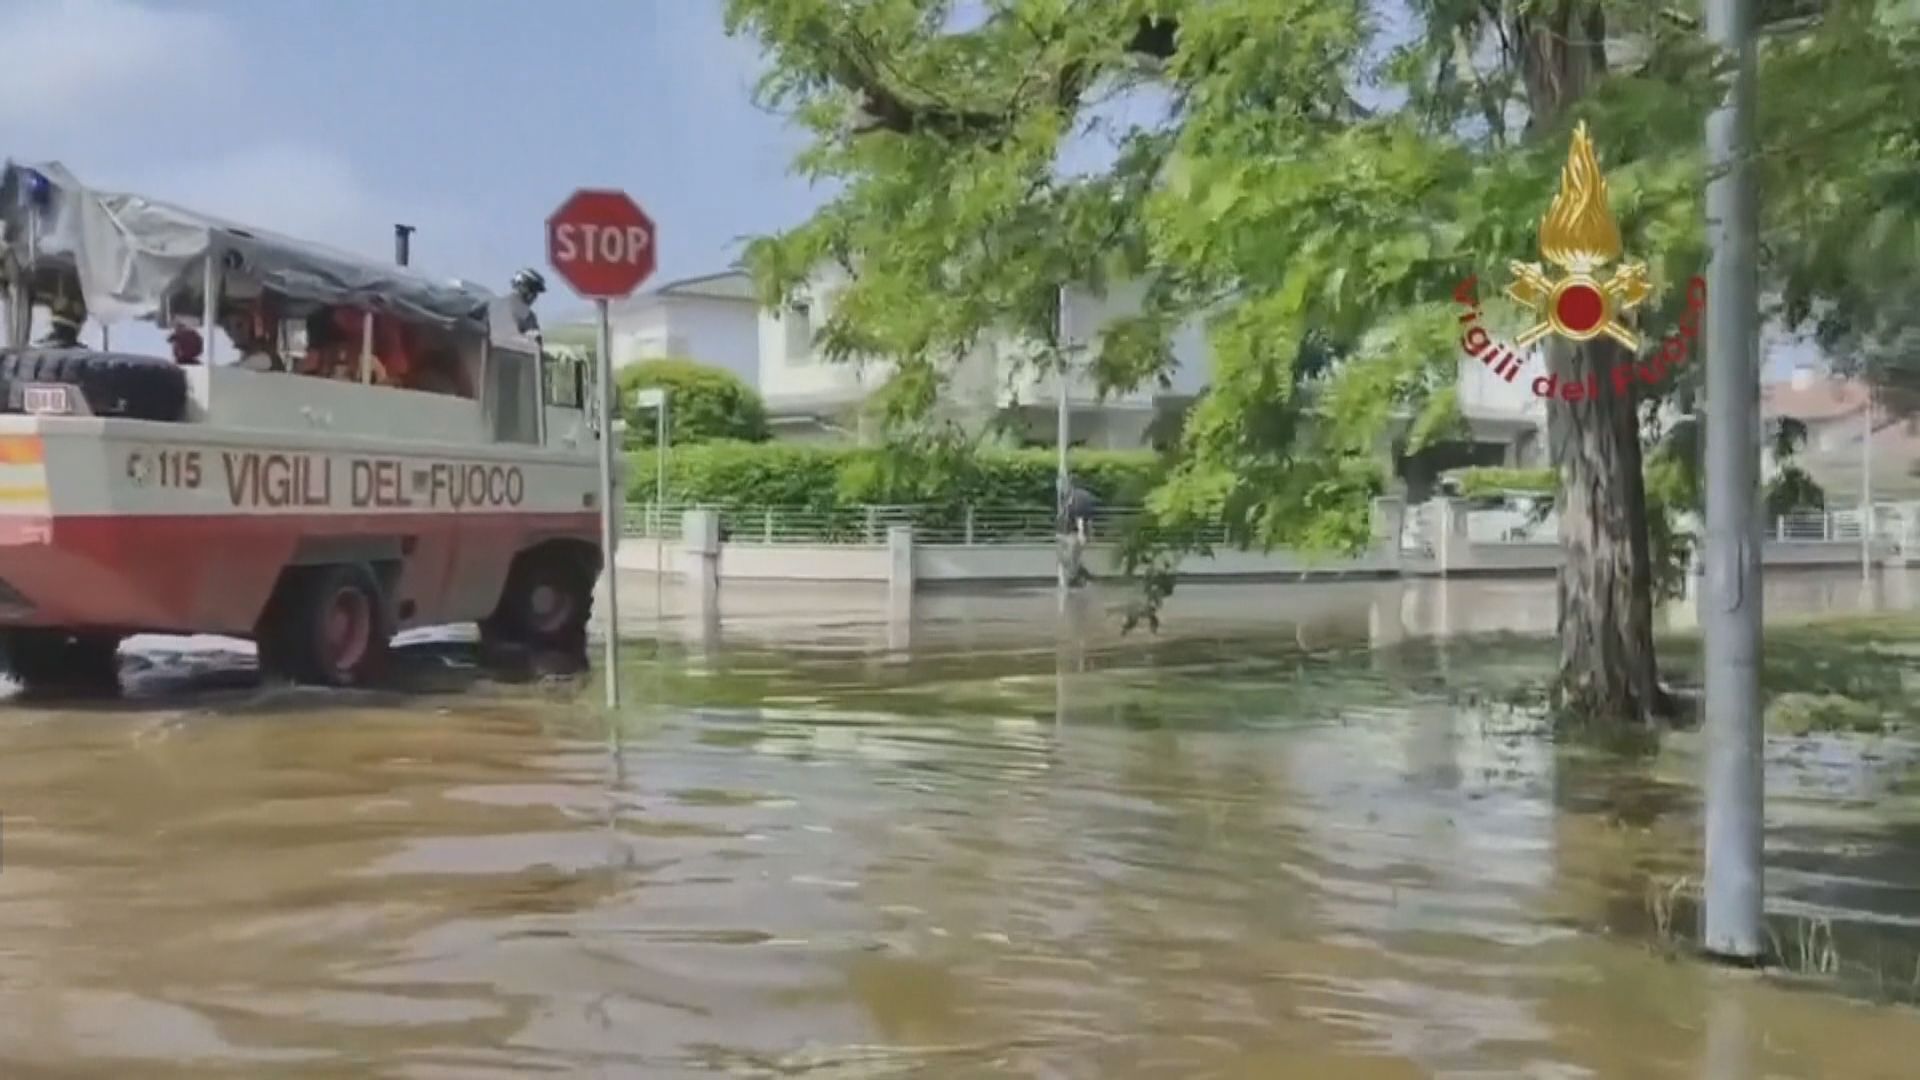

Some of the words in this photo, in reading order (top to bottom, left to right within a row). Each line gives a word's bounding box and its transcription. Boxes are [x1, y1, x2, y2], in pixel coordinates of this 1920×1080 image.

[556, 223, 649, 264] STOP
[159, 451, 201, 488] 115
[222, 452, 331, 507] VIGILI
[352, 460, 412, 507] DEL
[431, 463, 524, 507] FUOCO
